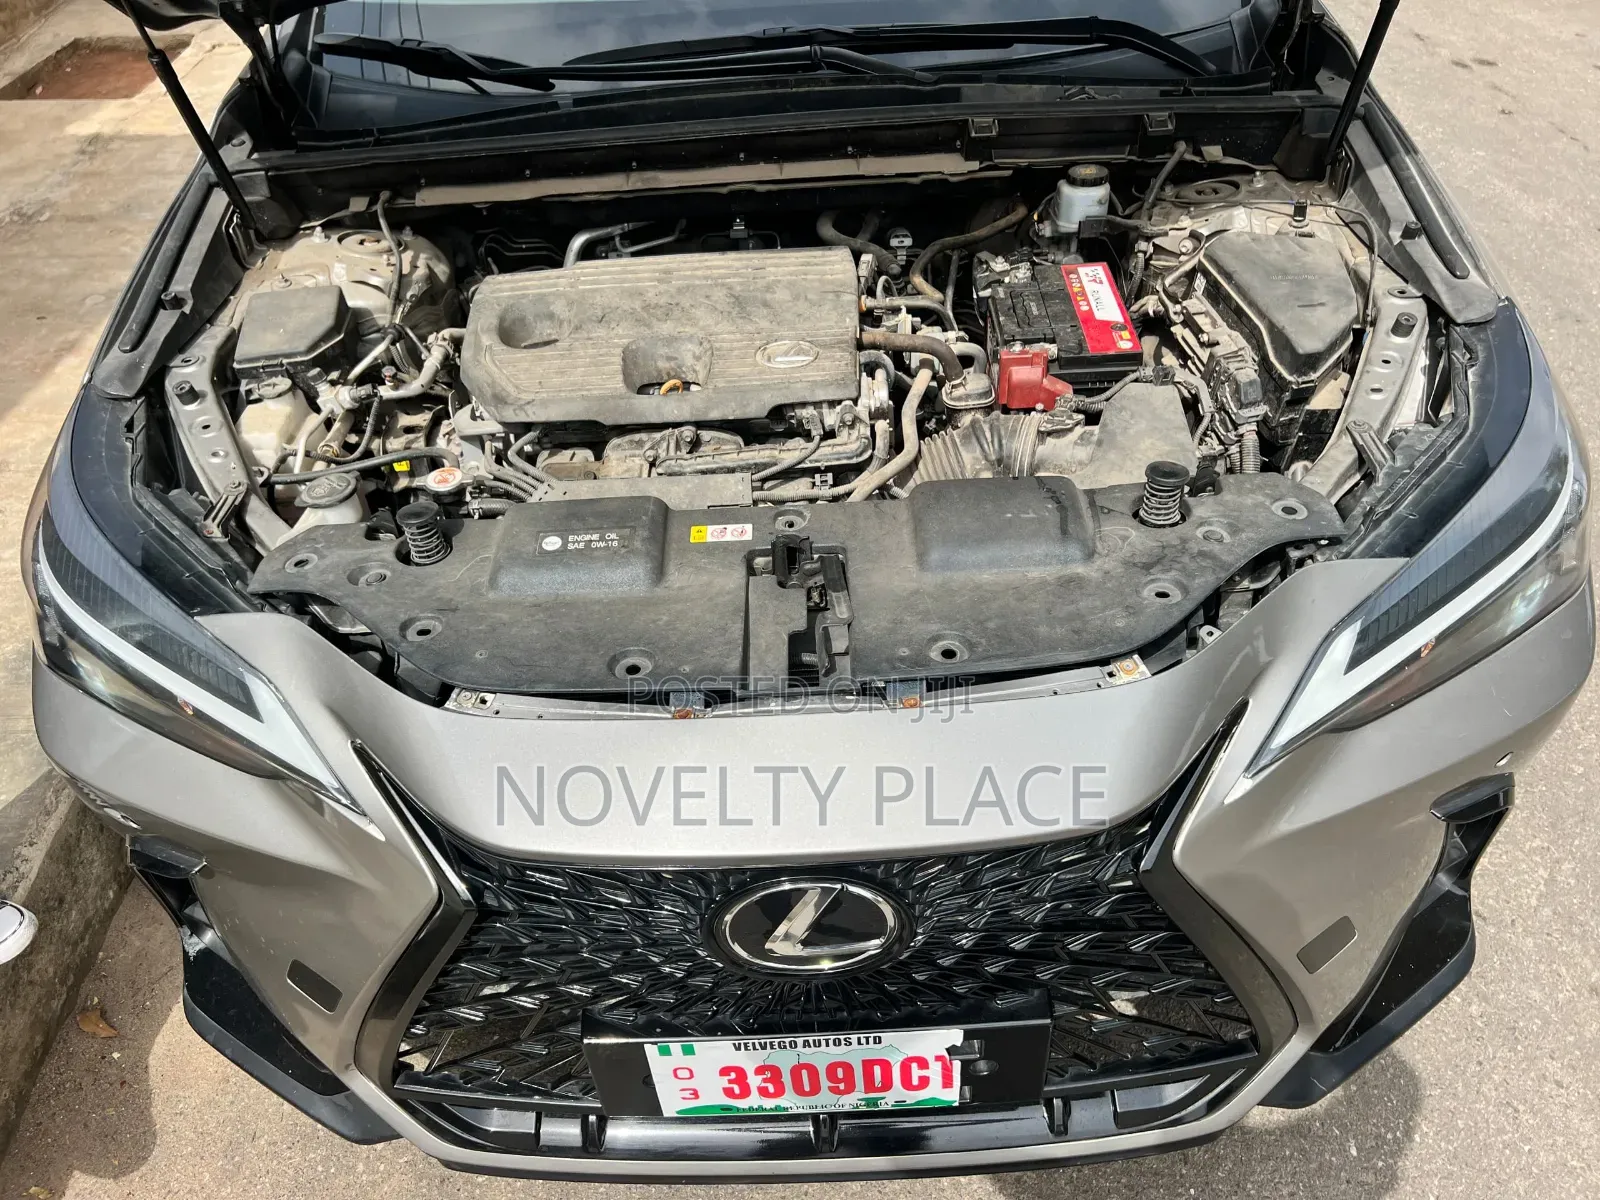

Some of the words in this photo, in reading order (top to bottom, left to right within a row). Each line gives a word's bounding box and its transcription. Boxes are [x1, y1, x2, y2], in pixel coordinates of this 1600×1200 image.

[568, 533, 600, 542] ENGINE
[605, 532, 619, 540] OIL
[567, 542, 585, 550] SAE
[591, 540, 618, 549] 0W-16
[732, 1040, 798, 1052] VELVEGO
[802, 1037, 852, 1049] AUTOS
[857, 1035, 883, 1046] LTD
